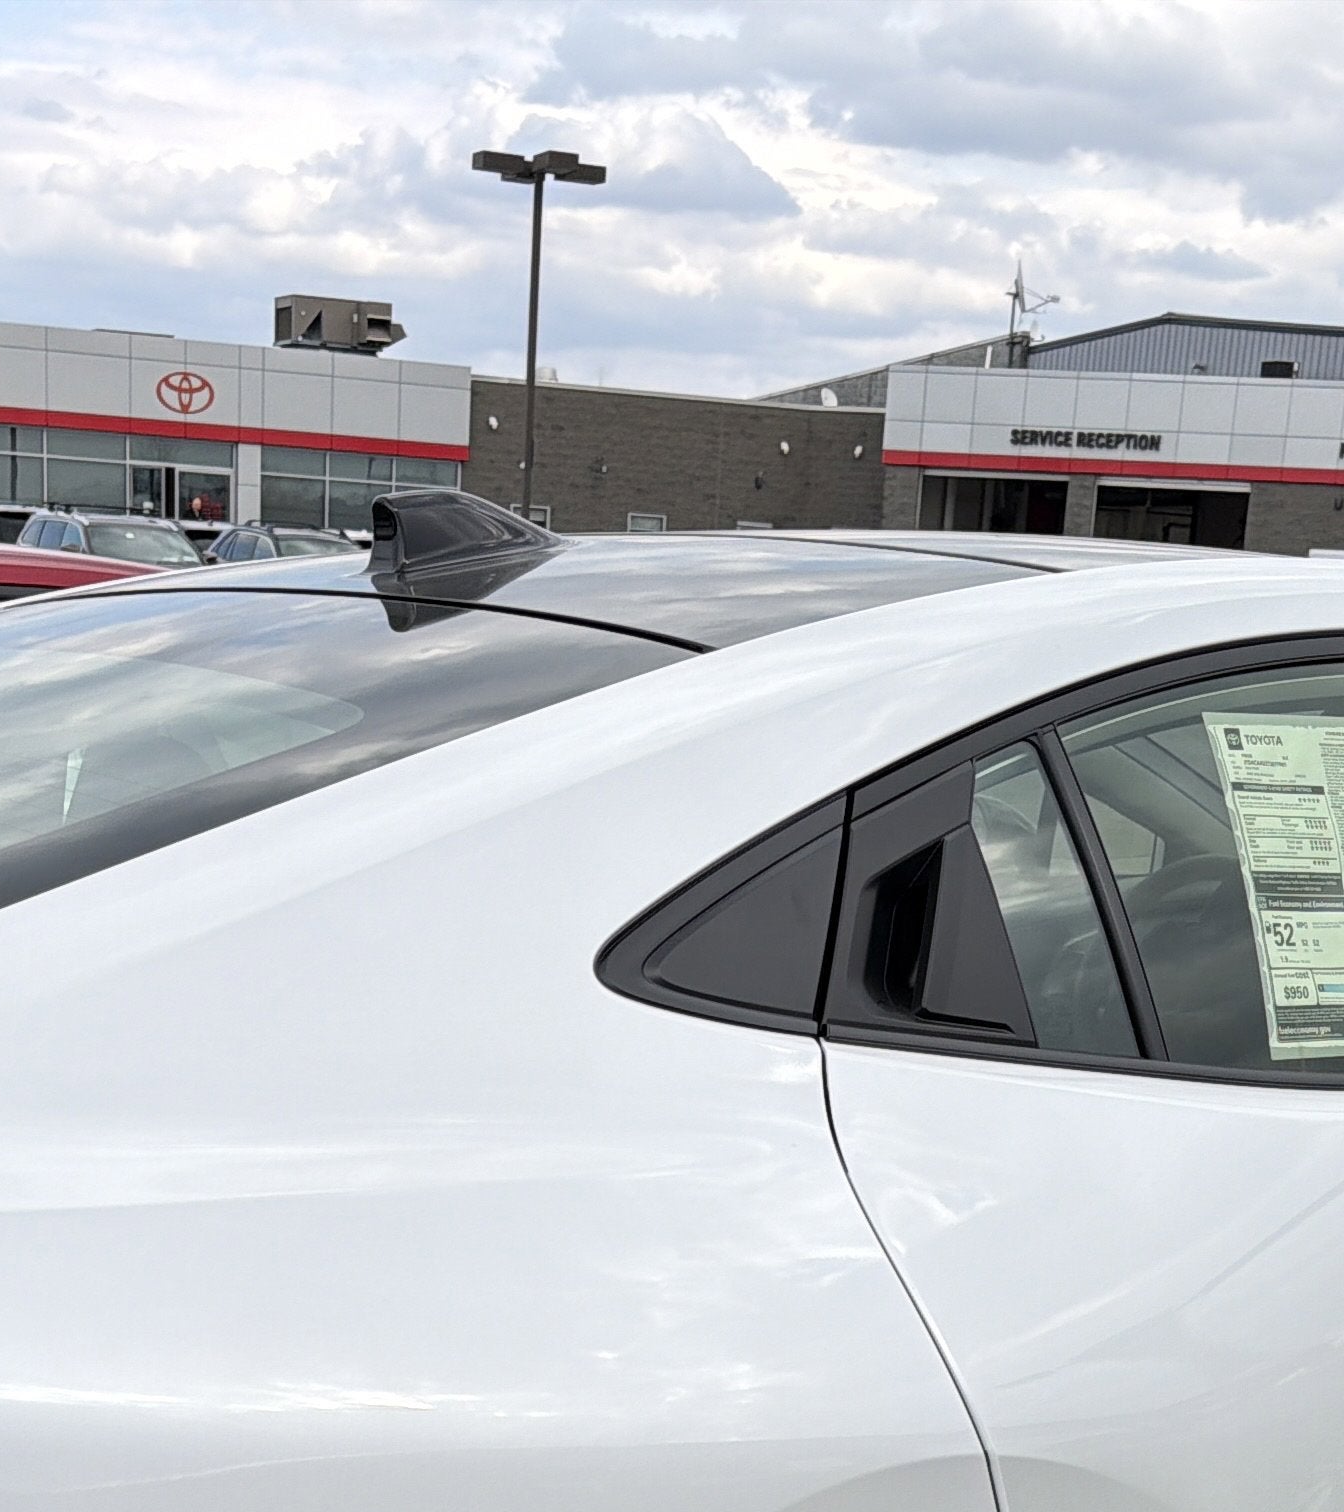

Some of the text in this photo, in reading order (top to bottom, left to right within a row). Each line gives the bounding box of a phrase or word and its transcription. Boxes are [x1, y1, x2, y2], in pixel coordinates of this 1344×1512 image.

[1009, 428, 1162, 452] SERVICE RECEPTION
[1243, 733, 1284, 747] TOYOTA
[1272, 922, 1296, 947] 52
[1283, 985, 1310, 1000] $950
